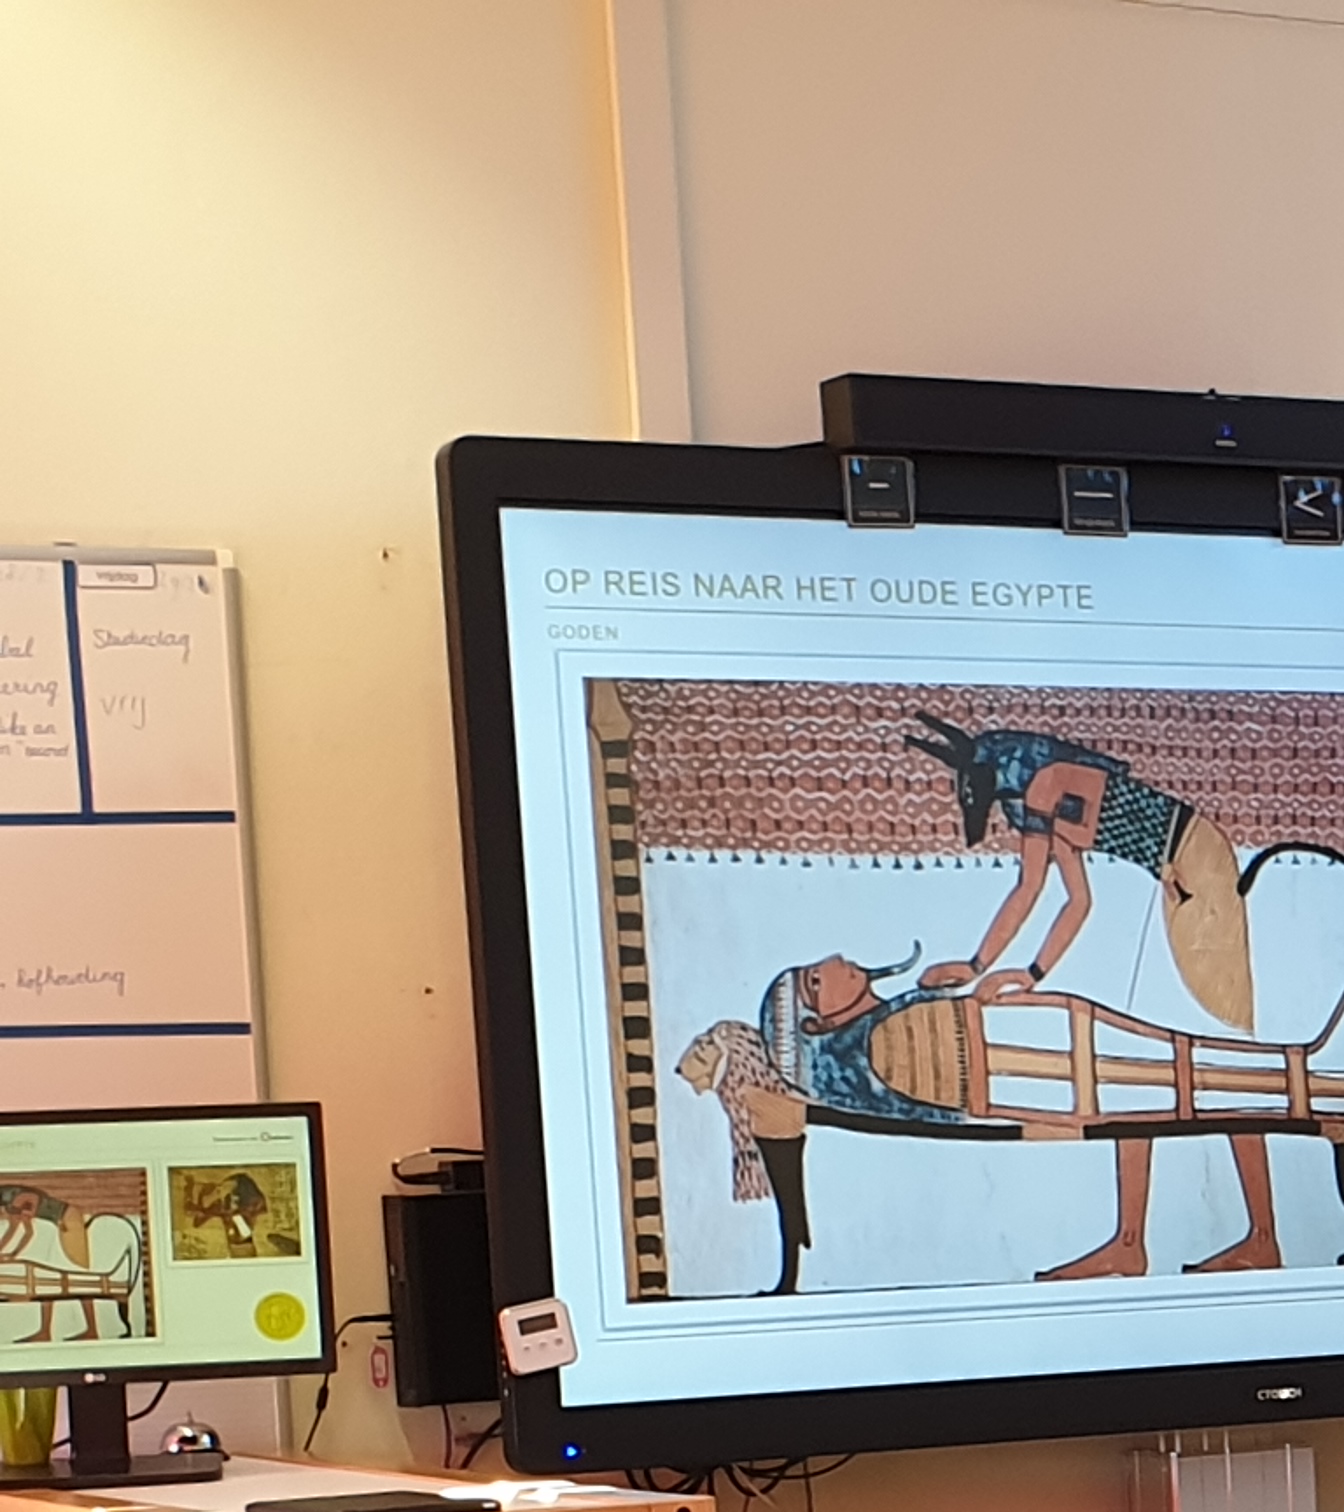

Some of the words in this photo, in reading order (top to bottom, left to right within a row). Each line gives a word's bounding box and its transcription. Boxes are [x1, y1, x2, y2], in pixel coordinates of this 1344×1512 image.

[543, 570, 593, 596] OP
[603, 571, 681, 599] REIS
[692, 573, 786, 602] NAAR
[794, 576, 859, 604] HET
[869, 578, 961, 608] OUDE
[969, 580, 1094, 612] EGYPTE
[547, 624, 618, 642] GODEN
[101, 695, 146, 729] vrij
